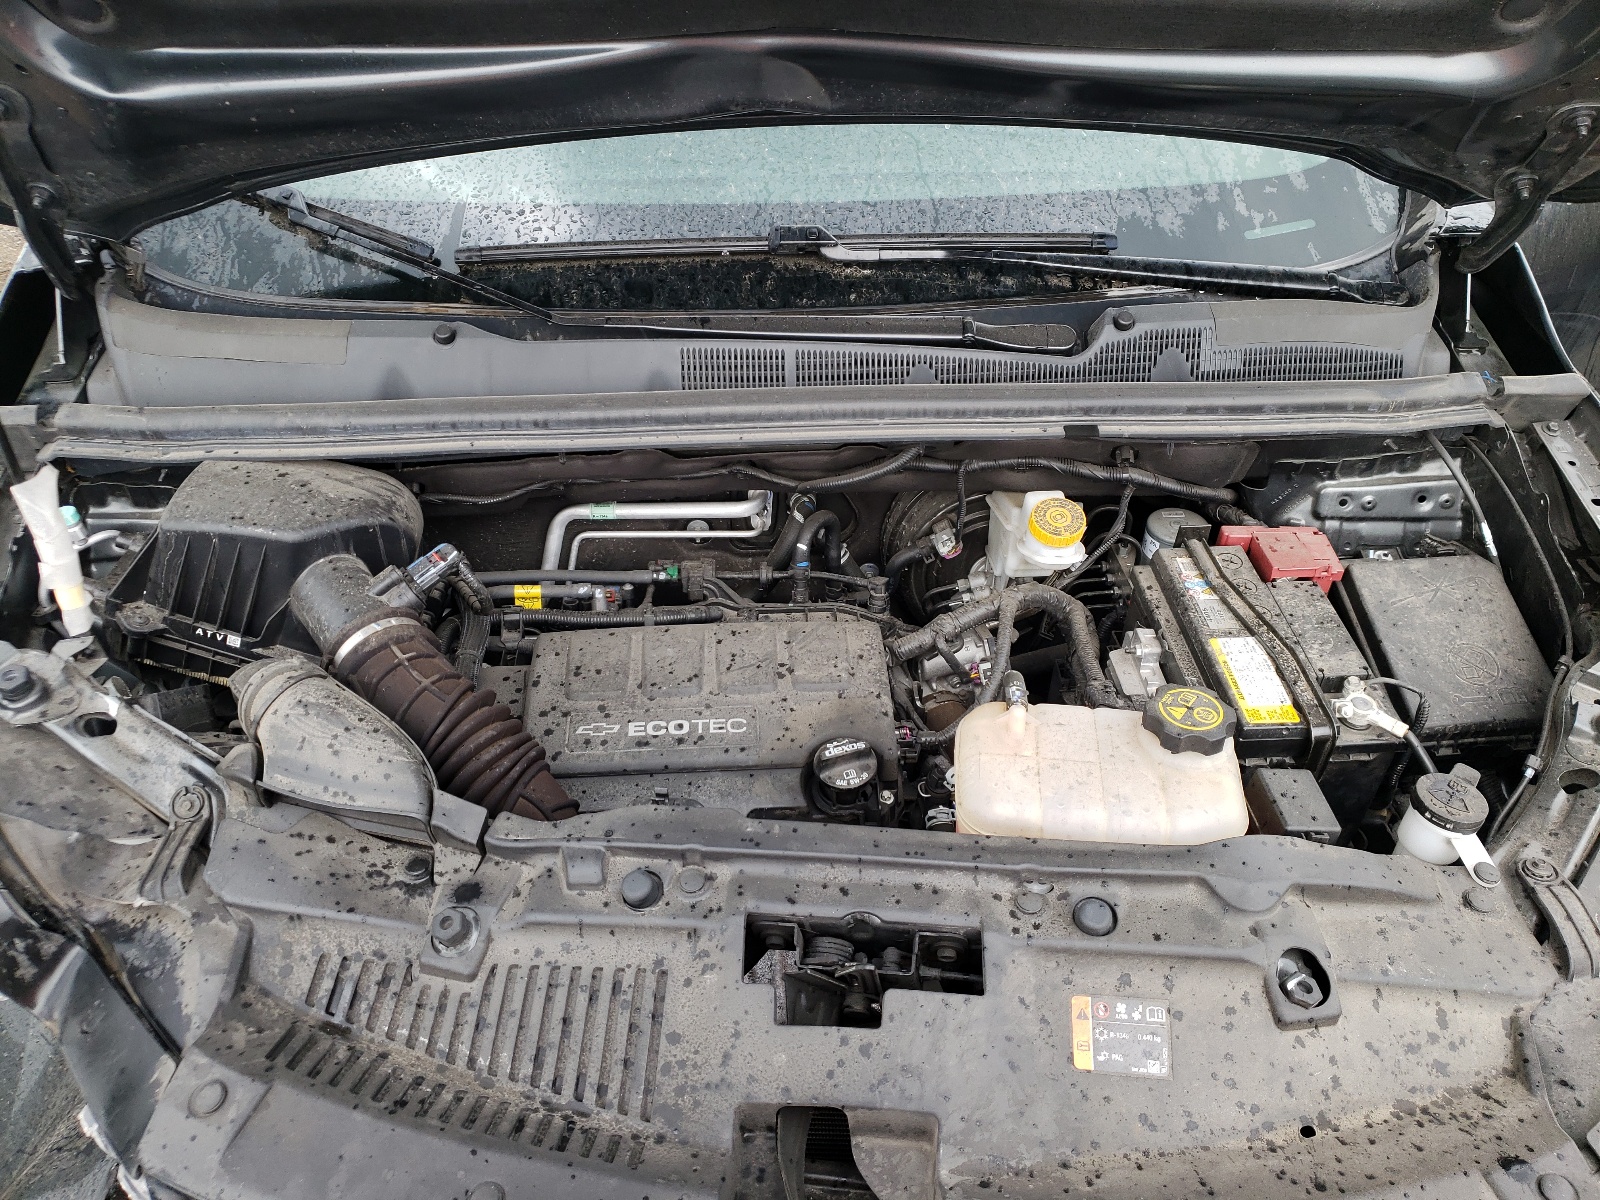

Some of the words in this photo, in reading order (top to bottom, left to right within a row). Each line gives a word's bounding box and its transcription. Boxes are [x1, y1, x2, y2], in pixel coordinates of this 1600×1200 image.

[195, 628, 225, 641] ATV
[627, 717, 748, 737] ECOTEC
[825, 741, 866, 756] dexos
[1112, 1053, 1124, 1061] PAG
